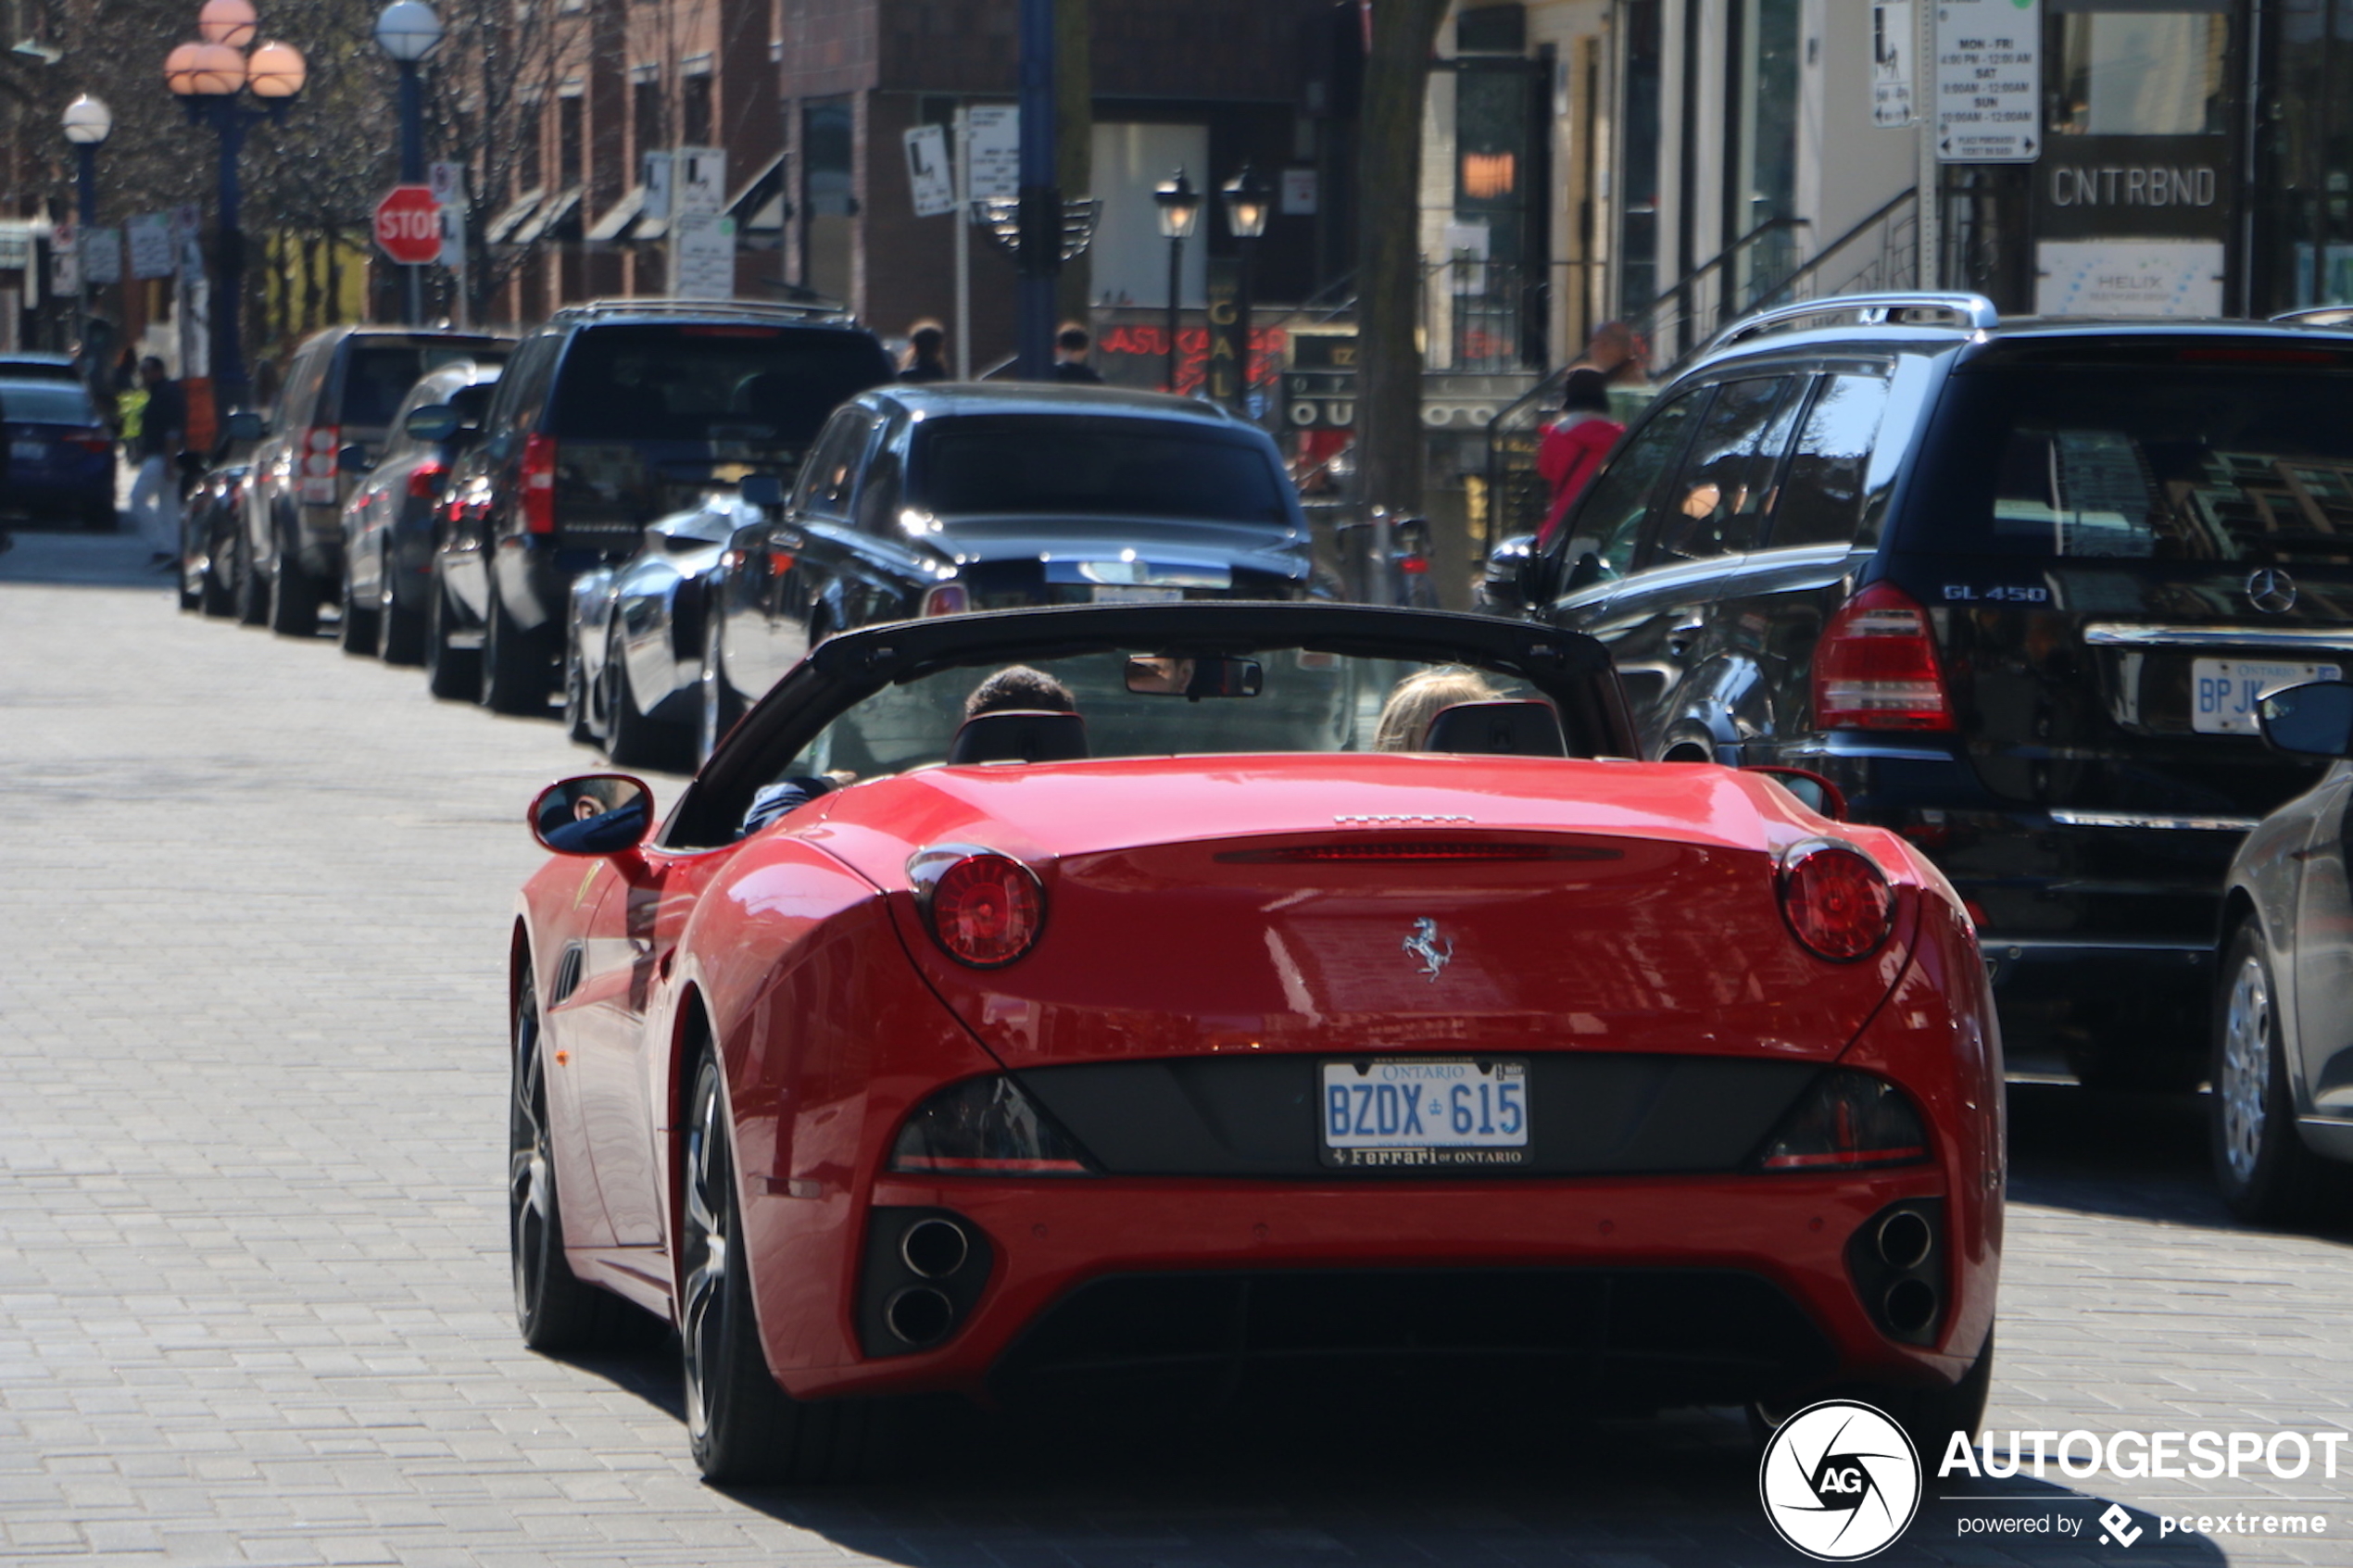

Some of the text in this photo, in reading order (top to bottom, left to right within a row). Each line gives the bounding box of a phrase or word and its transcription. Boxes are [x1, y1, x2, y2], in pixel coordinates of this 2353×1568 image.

[1959, 39, 1985, 49] MON
[1994, 39, 2014, 49] FRI
[1965, 54, 1980, 64] PM
[1989, 54, 2014, 64] 12:00
[2017, 54, 2032, 64] AM
[1975, 69, 1997, 79] SAT
[1989, 82, 2030, 94] 12:00AM
[1974, 97, 1998, 108] SUN
[1942, 112, 1982, 123] 10:00AM
[1991, 111, 2032, 122] 12:00AM
[2050, 168, 2216, 207] CNTRBND
[2098, 276, 2162, 289] HELIX
[1944, 584, 2047, 602] GL 450
[1327, 1083, 1522, 1136] BZDX 615
[1351, 1147, 1437, 1165] Ferrari
[1454, 1151, 1522, 1164] ONTARIO
